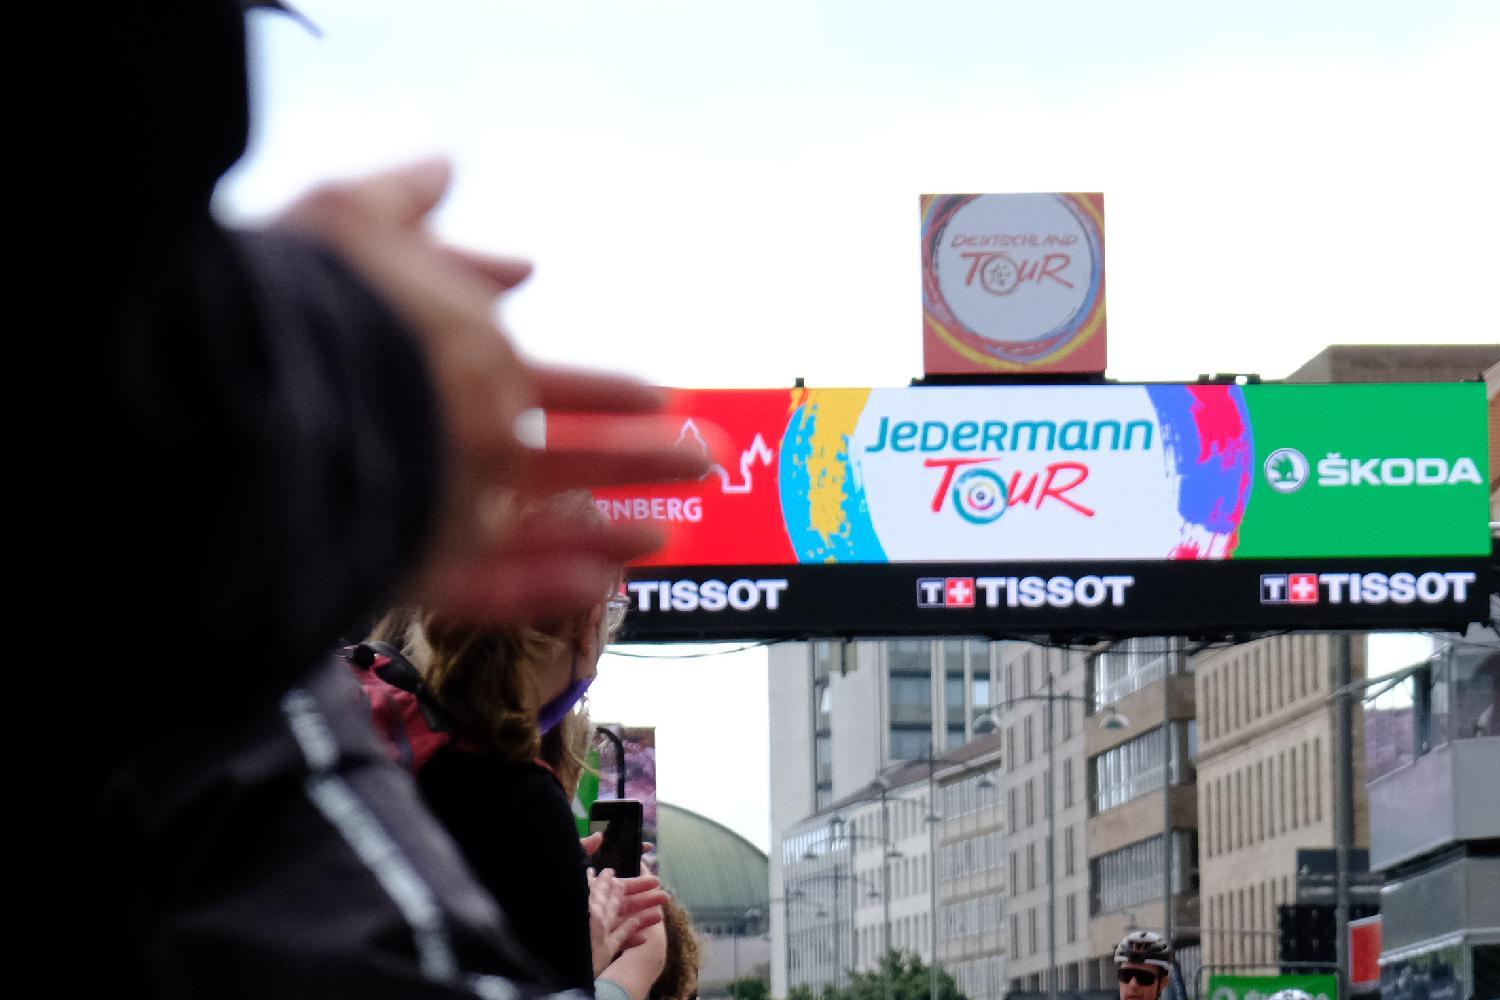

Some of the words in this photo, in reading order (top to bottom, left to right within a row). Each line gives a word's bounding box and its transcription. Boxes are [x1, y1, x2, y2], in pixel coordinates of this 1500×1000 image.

[951, 233, 1078, 247] DEUTSCHLAND
[1317, 452, 1483, 486] ŠKODA
[628, 579, 788, 611] TISSOT
[976, 575, 1134, 607] TISSOT
[1319, 572, 1476, 603] TISSOT
